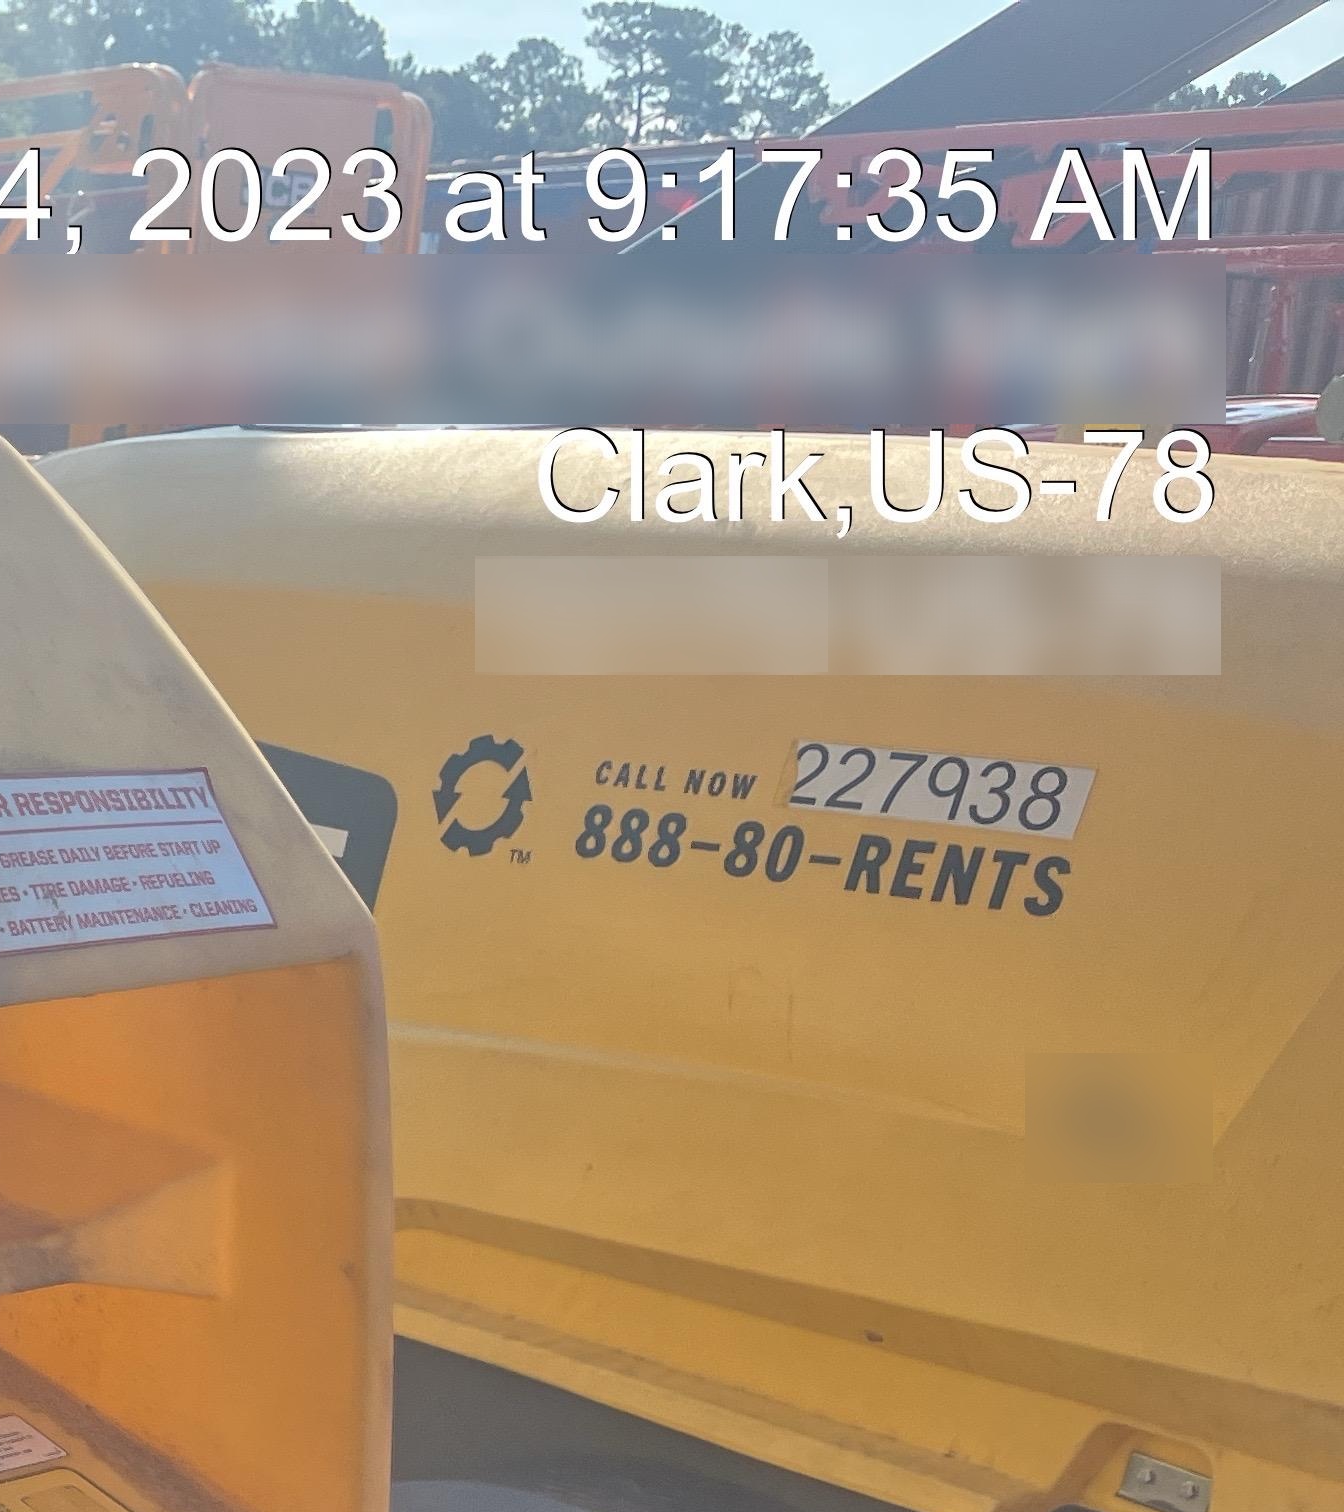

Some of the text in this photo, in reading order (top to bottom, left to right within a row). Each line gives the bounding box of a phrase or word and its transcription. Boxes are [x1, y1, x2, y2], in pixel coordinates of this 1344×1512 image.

[594, 760, 759, 801] CALL NOW
[788, 742, 1069, 831] 227938
[12, 786, 209, 817] RESPONSIBILITY
[0, 849, 59, 869] GREASE
[61, 845, 102, 863] DAILY
[103, 842, 157, 861] BEFORE
[158, 839, 200, 857] START
[201, 838, 221, 854] UP
[575, 803, 1072, 918] 888-80-RENTS
[29, 882, 67, 900] TIRE
[68, 876, 130, 897] DAMAGE
[138, 870, 215, 891] REFUELING
[7, 915, 74, 937] BATTERY
[76, 903, 180, 930] MAINTENANCE
[189, 898, 258, 918] CLEANING
